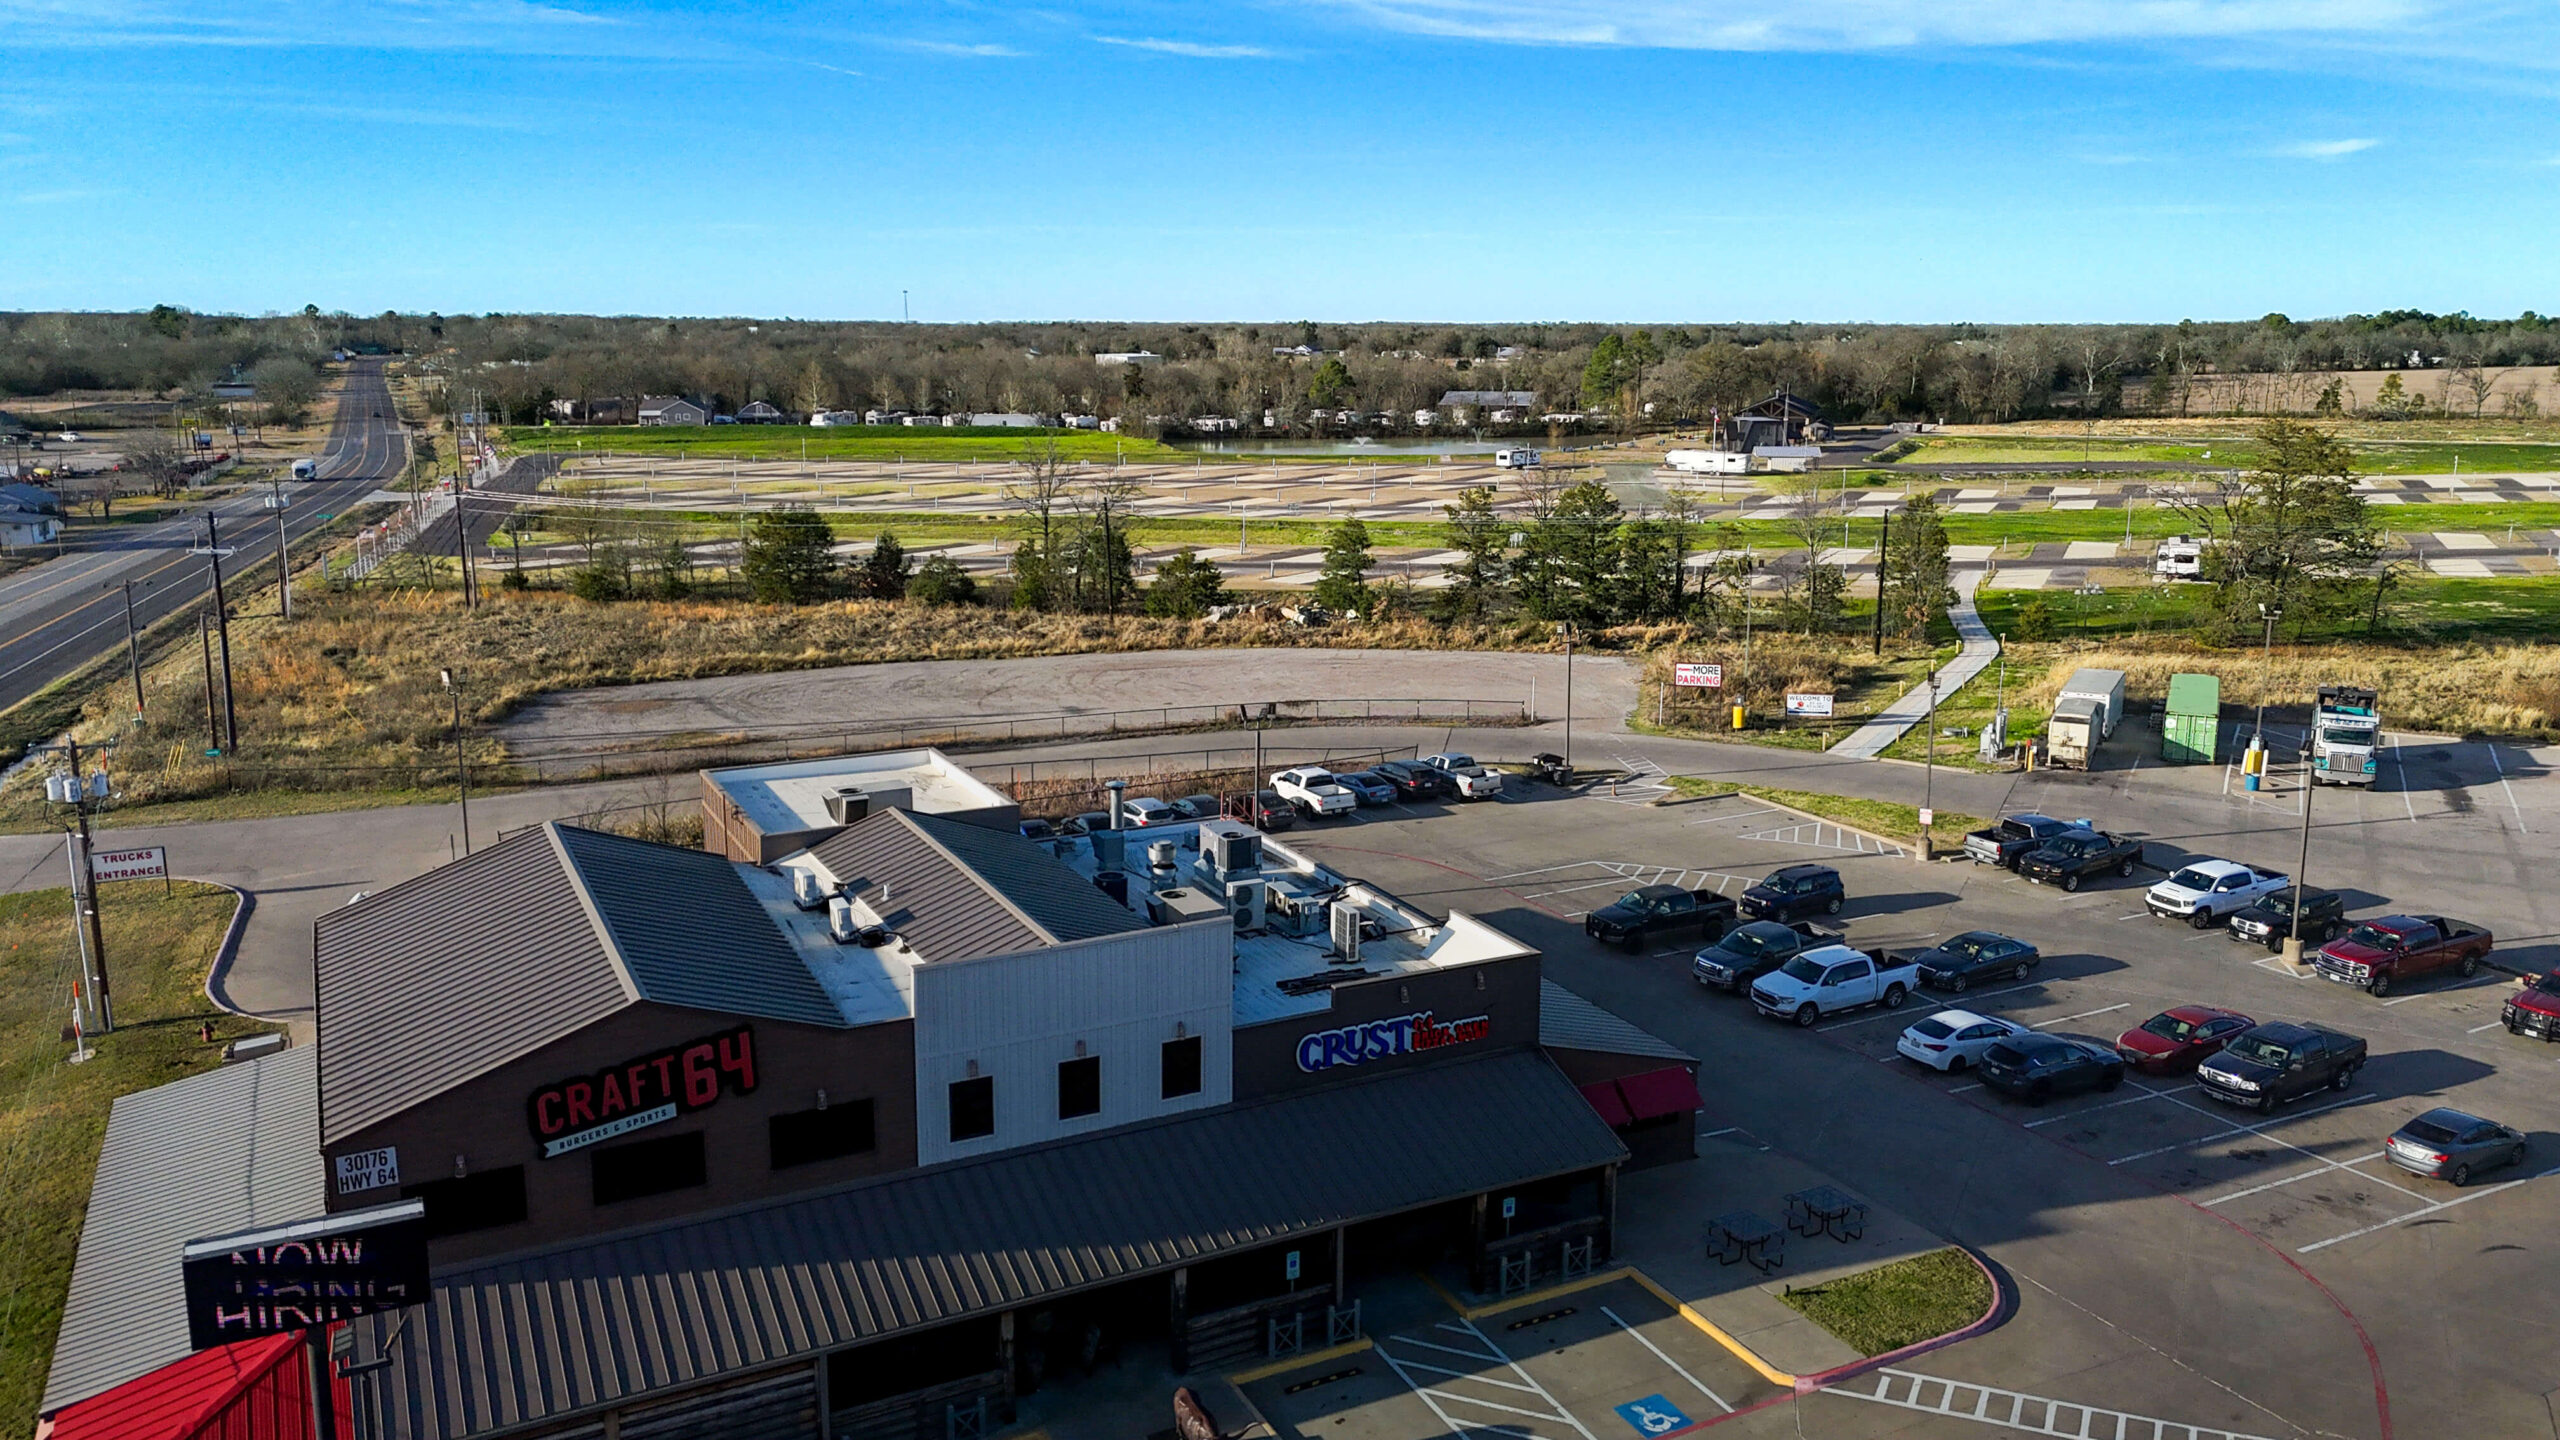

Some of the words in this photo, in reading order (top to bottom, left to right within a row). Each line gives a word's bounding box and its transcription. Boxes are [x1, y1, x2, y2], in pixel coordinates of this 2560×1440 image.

[1693, 666, 1719, 675] MORE
[1677, 675, 1719, 685] PARKING
[102, 851, 153, 863] TRUCKS
[95, 866, 163, 880] ENTRANCE
[1299, 1019, 1413, 1071] CRUST
[559, 1128, 609, 1149] BURGERS
[626, 1109, 667, 1129] SPORTS
[344, 1150, 388, 1173] 30176
[340, 1170, 372, 1193] HWY
[377, 1166, 397, 1185] 64
